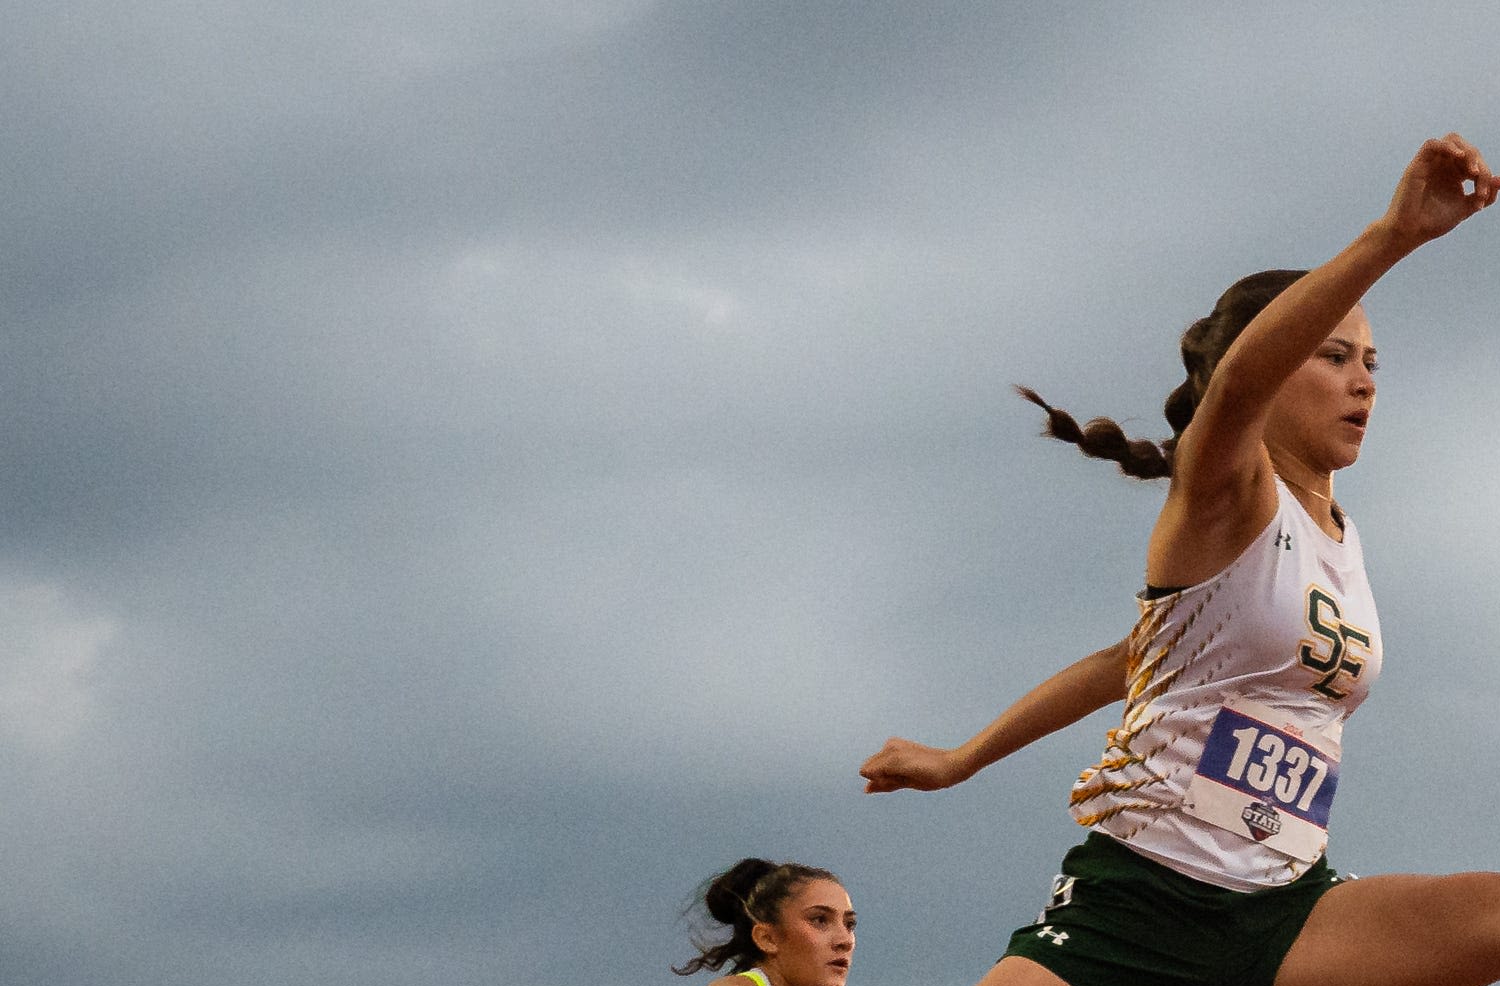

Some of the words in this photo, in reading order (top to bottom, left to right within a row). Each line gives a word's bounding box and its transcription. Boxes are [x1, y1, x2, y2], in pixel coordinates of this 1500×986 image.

[1297, 583, 1373, 702] SF
[1226, 726, 1328, 812] 1337
[1242, 807, 1281, 833] STATE
